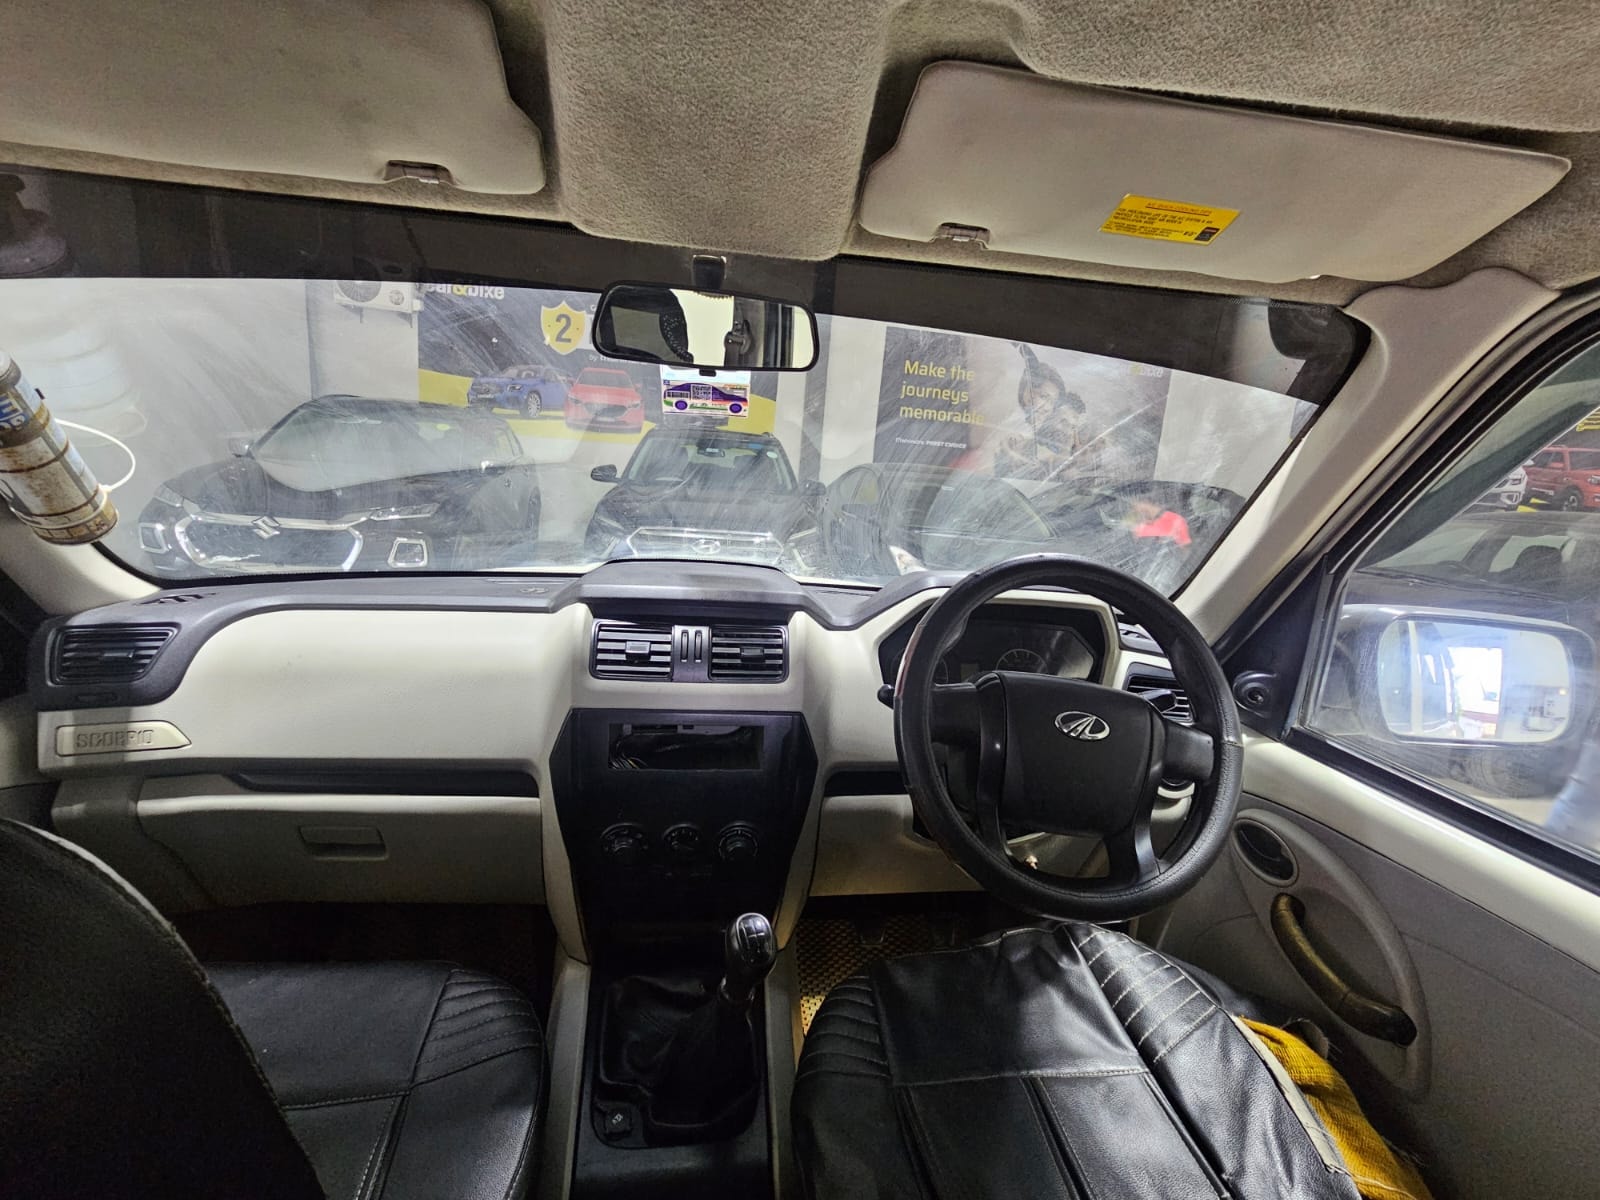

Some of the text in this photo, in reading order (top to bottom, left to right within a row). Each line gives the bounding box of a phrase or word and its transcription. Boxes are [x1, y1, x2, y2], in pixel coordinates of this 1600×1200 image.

[555, 313, 572, 343] 2
[904, 360, 976, 381] Make the
[900, 380, 969, 405] journeys
[900, 406, 985, 426] memorable
